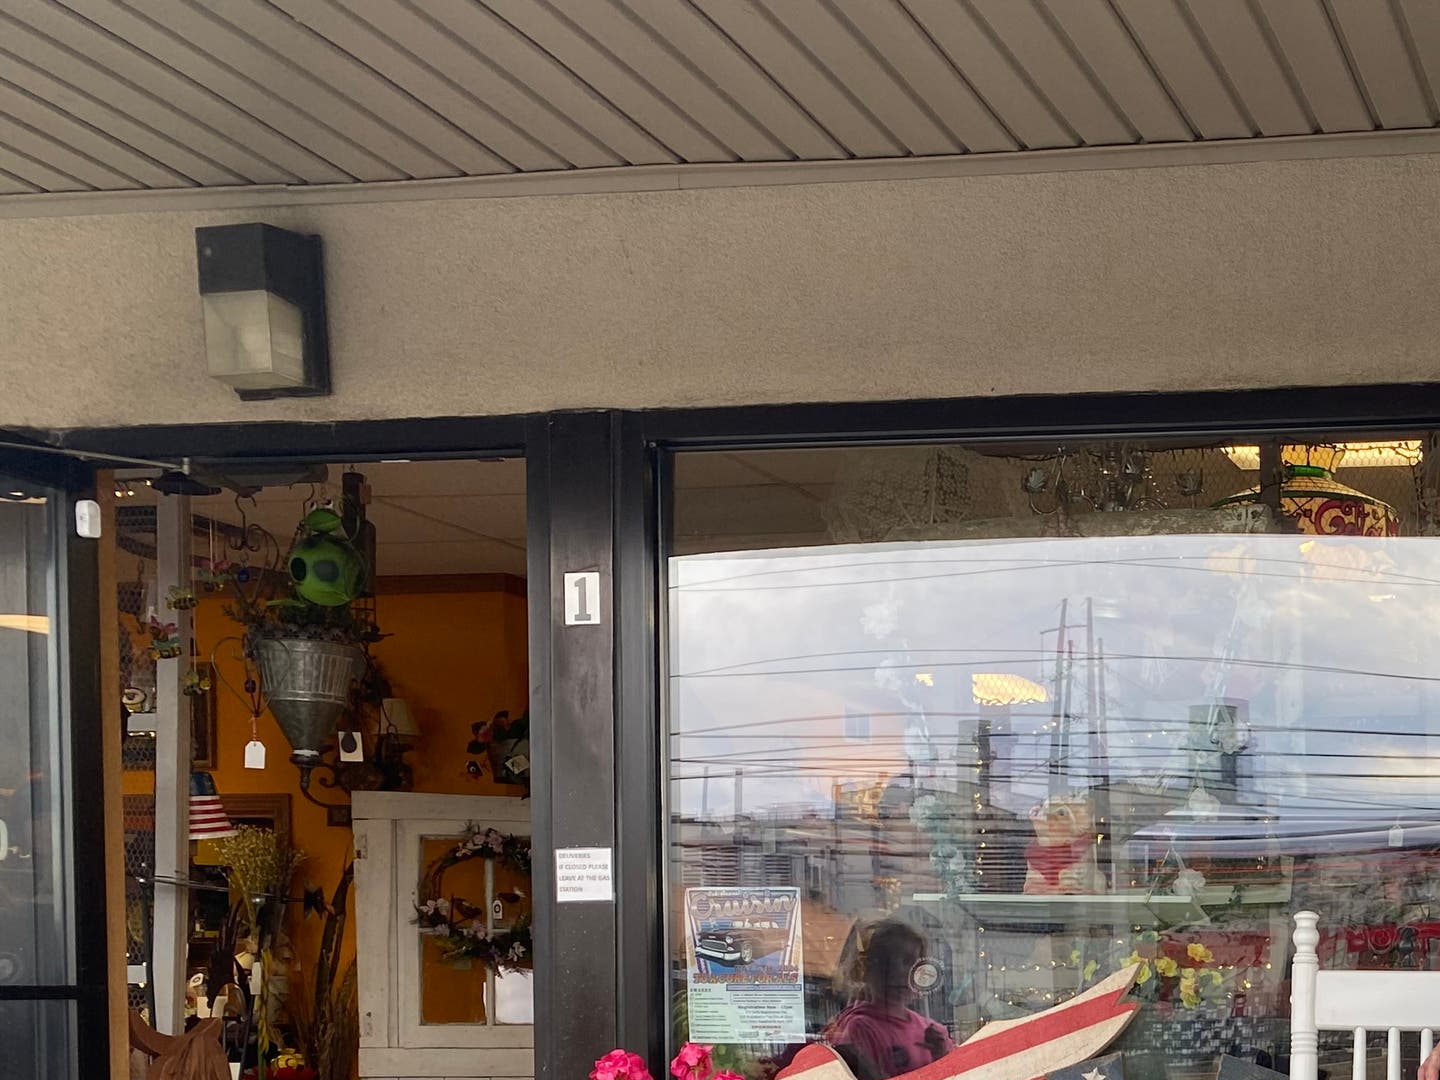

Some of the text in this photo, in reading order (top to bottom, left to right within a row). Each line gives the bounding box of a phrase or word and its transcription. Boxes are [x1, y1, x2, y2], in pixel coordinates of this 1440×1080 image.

[574, 577, 591, 621] 1
[693, 973, 707, 984] TO
[719, 973, 749, 984] CURE
[751, 973, 773, 984] FOR
[775, 972, 799, 984] ALS
